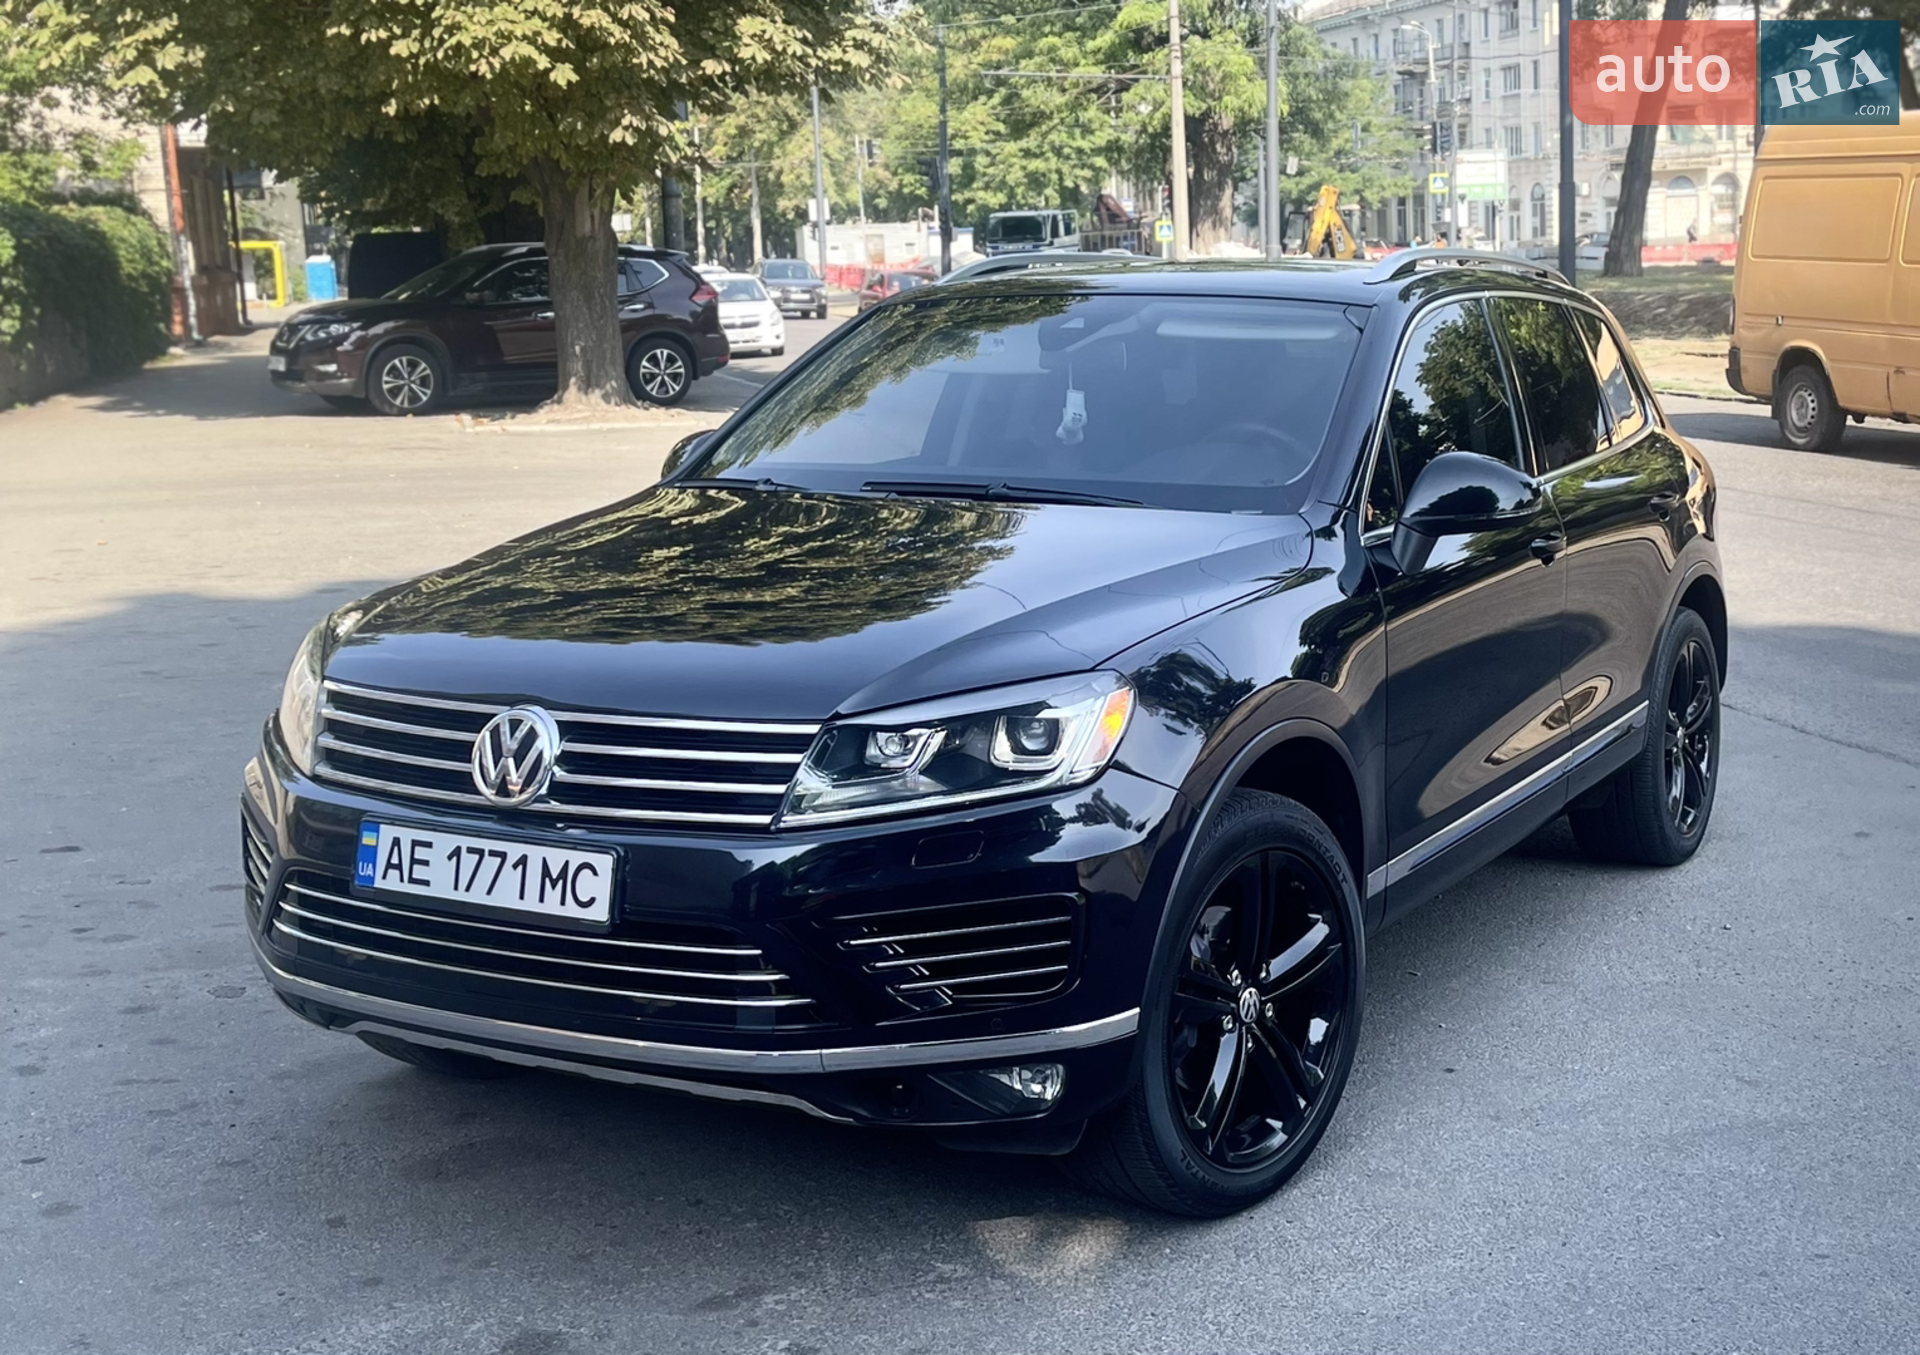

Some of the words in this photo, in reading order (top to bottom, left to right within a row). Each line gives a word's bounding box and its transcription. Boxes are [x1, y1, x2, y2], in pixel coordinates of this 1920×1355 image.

[358, 861, 374, 877] UA
[381, 836, 434, 887] AE
[446, 844, 528, 900] 1771
[538, 856, 600, 908] MC
